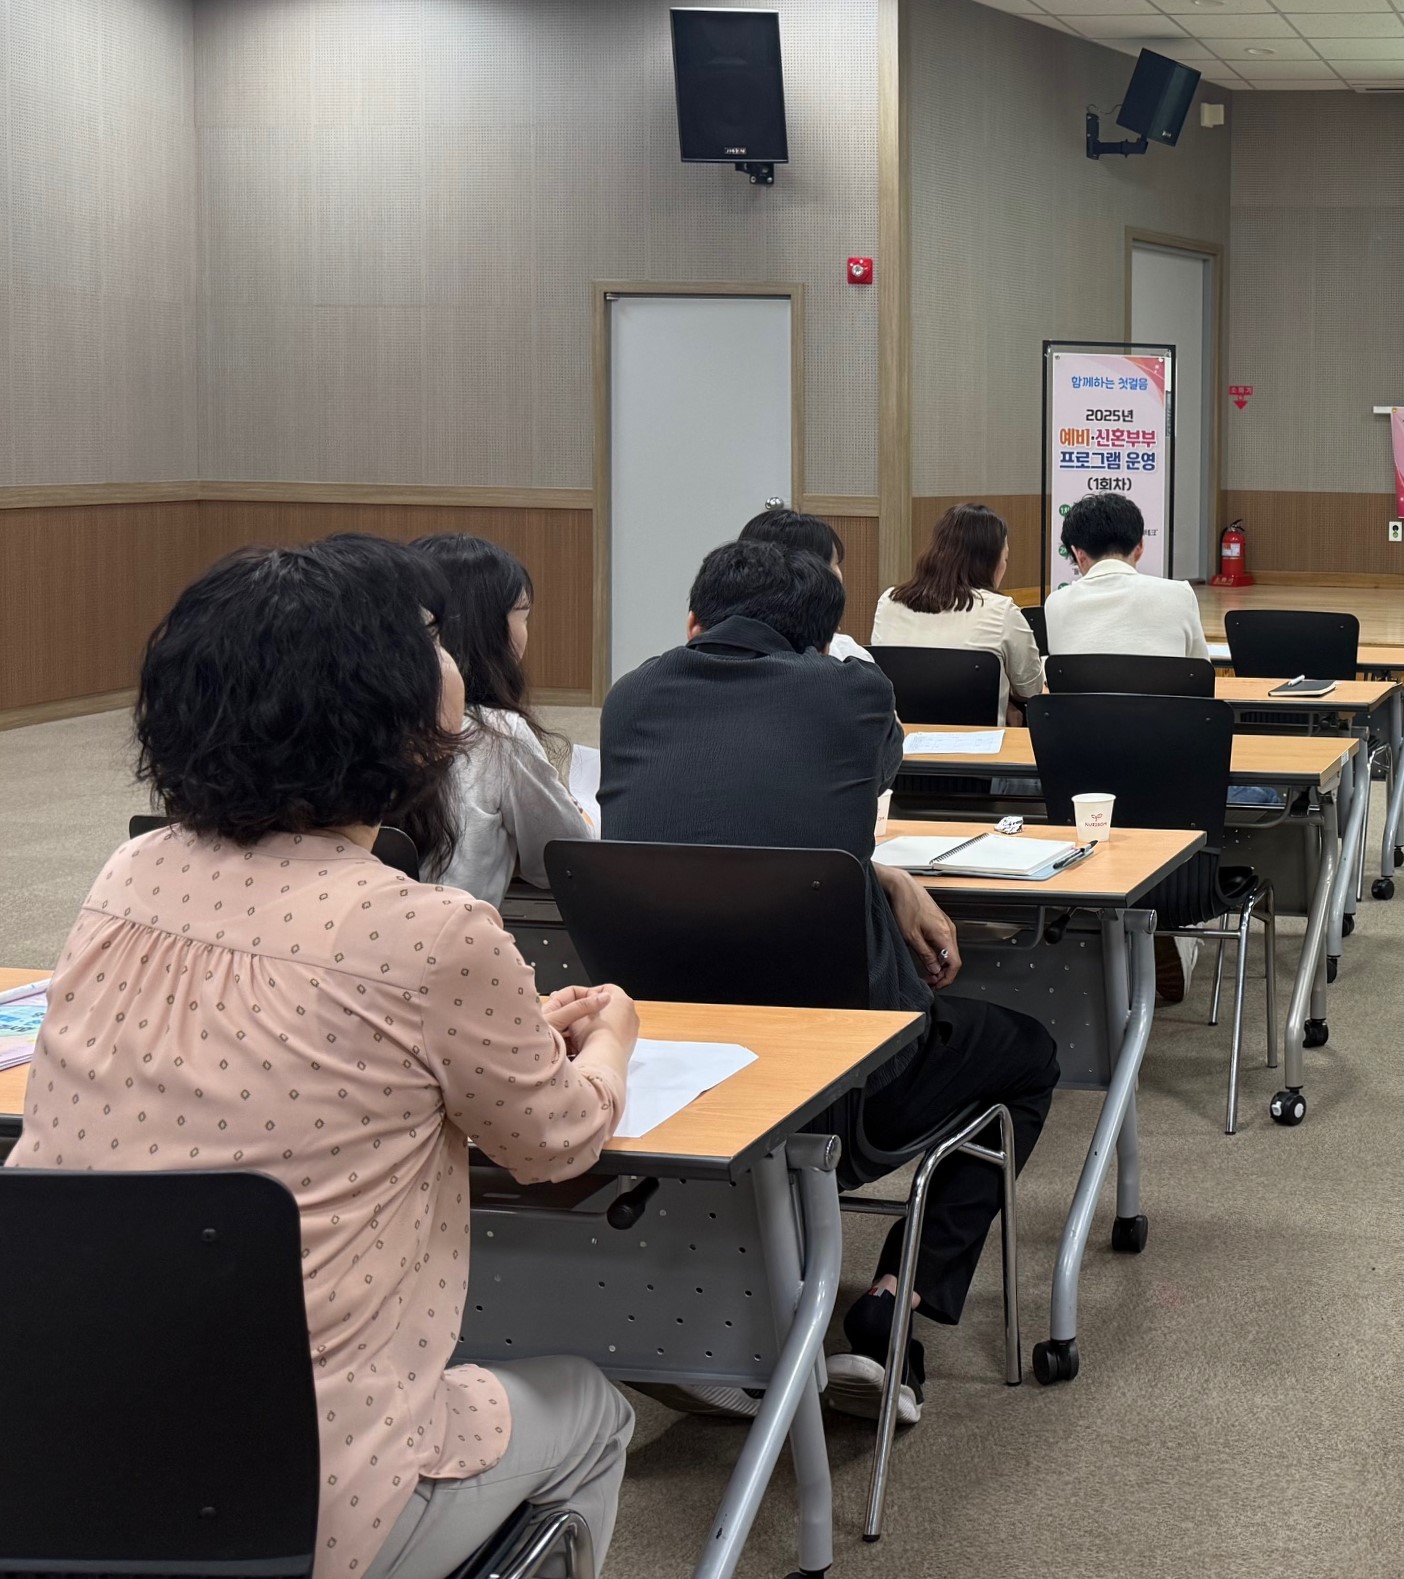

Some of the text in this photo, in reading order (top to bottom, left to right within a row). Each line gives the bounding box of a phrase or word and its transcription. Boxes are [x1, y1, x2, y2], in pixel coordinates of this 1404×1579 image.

[1071, 376, 1148, 390] 함께하는 첫걸음
[1086, 409, 1134, 423] 2025년
[1060, 428, 1156, 448] 예비·신혼부부
[1060, 451, 1156, 471] 프로그램 운영
[1087, 477, 1132, 491] (1회차)
